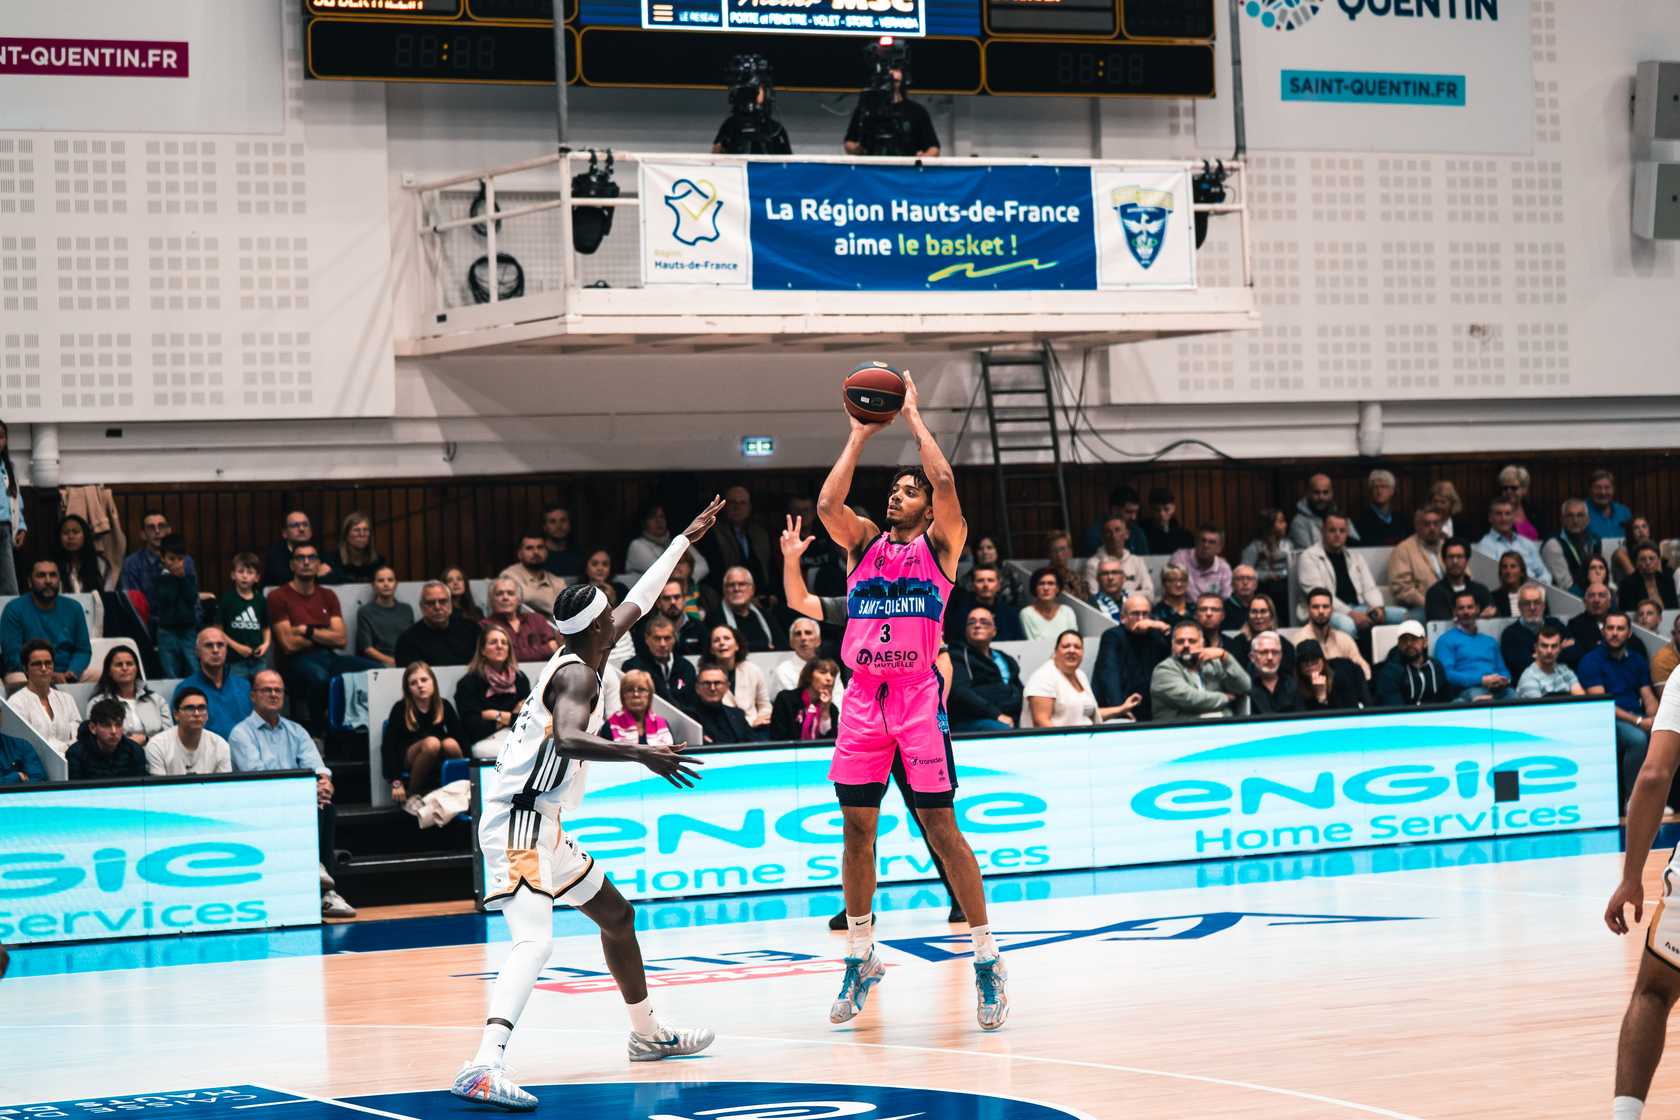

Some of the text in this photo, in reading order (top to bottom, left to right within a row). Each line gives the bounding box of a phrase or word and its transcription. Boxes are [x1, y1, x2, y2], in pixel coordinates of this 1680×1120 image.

[1289, 77, 1458, 99] SAINT-QUENTIN.FR
[765, 198, 1080, 226] La Région Hauts-de-France
[834, 232, 1018, 256] aime le basket !
[655, 261, 738, 271] Hauts-de-France
[880, 623, 891, 643] 3
[1195, 804, 1582, 853] Home Services
[606, 863, 786, 893] Home
